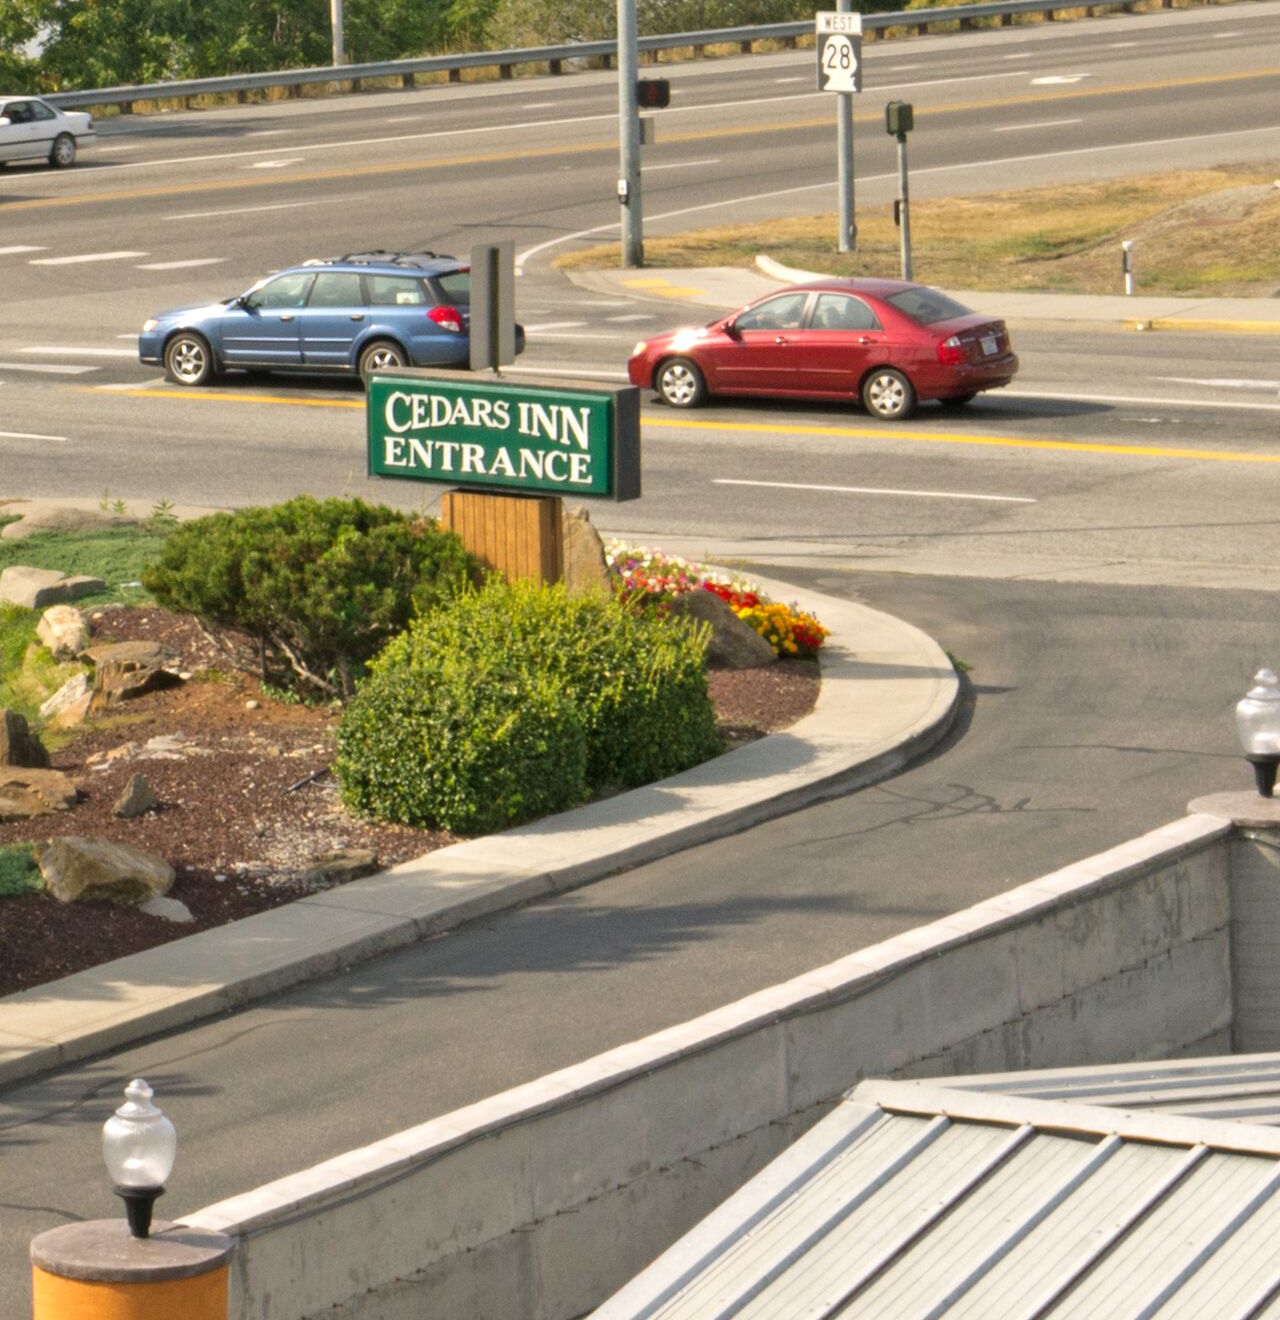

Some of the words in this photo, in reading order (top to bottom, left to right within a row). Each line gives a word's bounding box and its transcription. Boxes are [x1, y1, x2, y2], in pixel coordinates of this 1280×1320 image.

[824, 16, 853, 30] WEST
[827, 43, 850, 70] 28
[384, 391, 511, 432] CEDARS
[518, 402, 591, 451] INN
[383, 435, 593, 485] ENTRANCE
